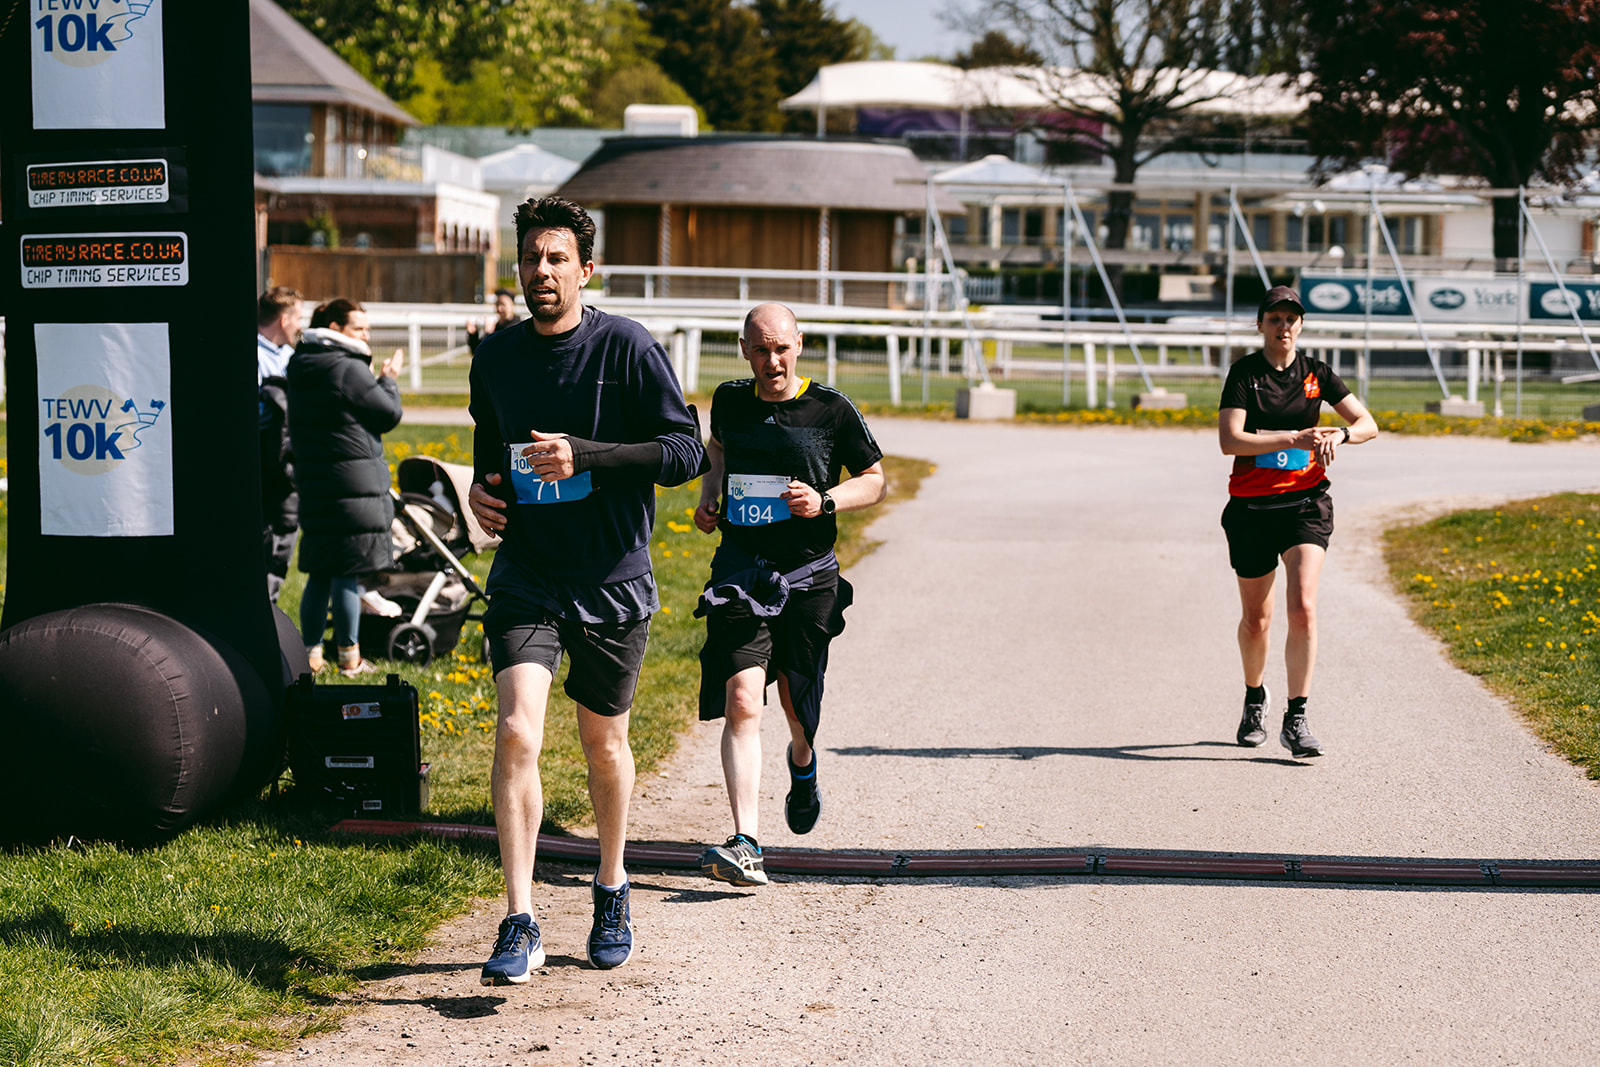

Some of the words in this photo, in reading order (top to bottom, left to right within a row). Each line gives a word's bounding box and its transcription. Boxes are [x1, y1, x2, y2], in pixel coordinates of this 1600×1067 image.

[35, 13, 118, 52] 10k
[33, 192, 56, 205] CHIP
[60, 190, 97, 204] TIMING
[101, 187, 163, 202] SERVICES
[26, 269, 52, 284] CHIP
[57, 268, 101, 284] TIMING
[107, 267, 181, 283] SERVICES
[1473, 287, 1518, 305] York
[42, 398, 113, 419] TEWV
[44, 422, 126, 461] 10k
[1277, 451, 1288, 468] 9
[533, 478, 560, 501] 71
[730, 486, 745, 497] 10k
[738, 504, 774, 524] 194
